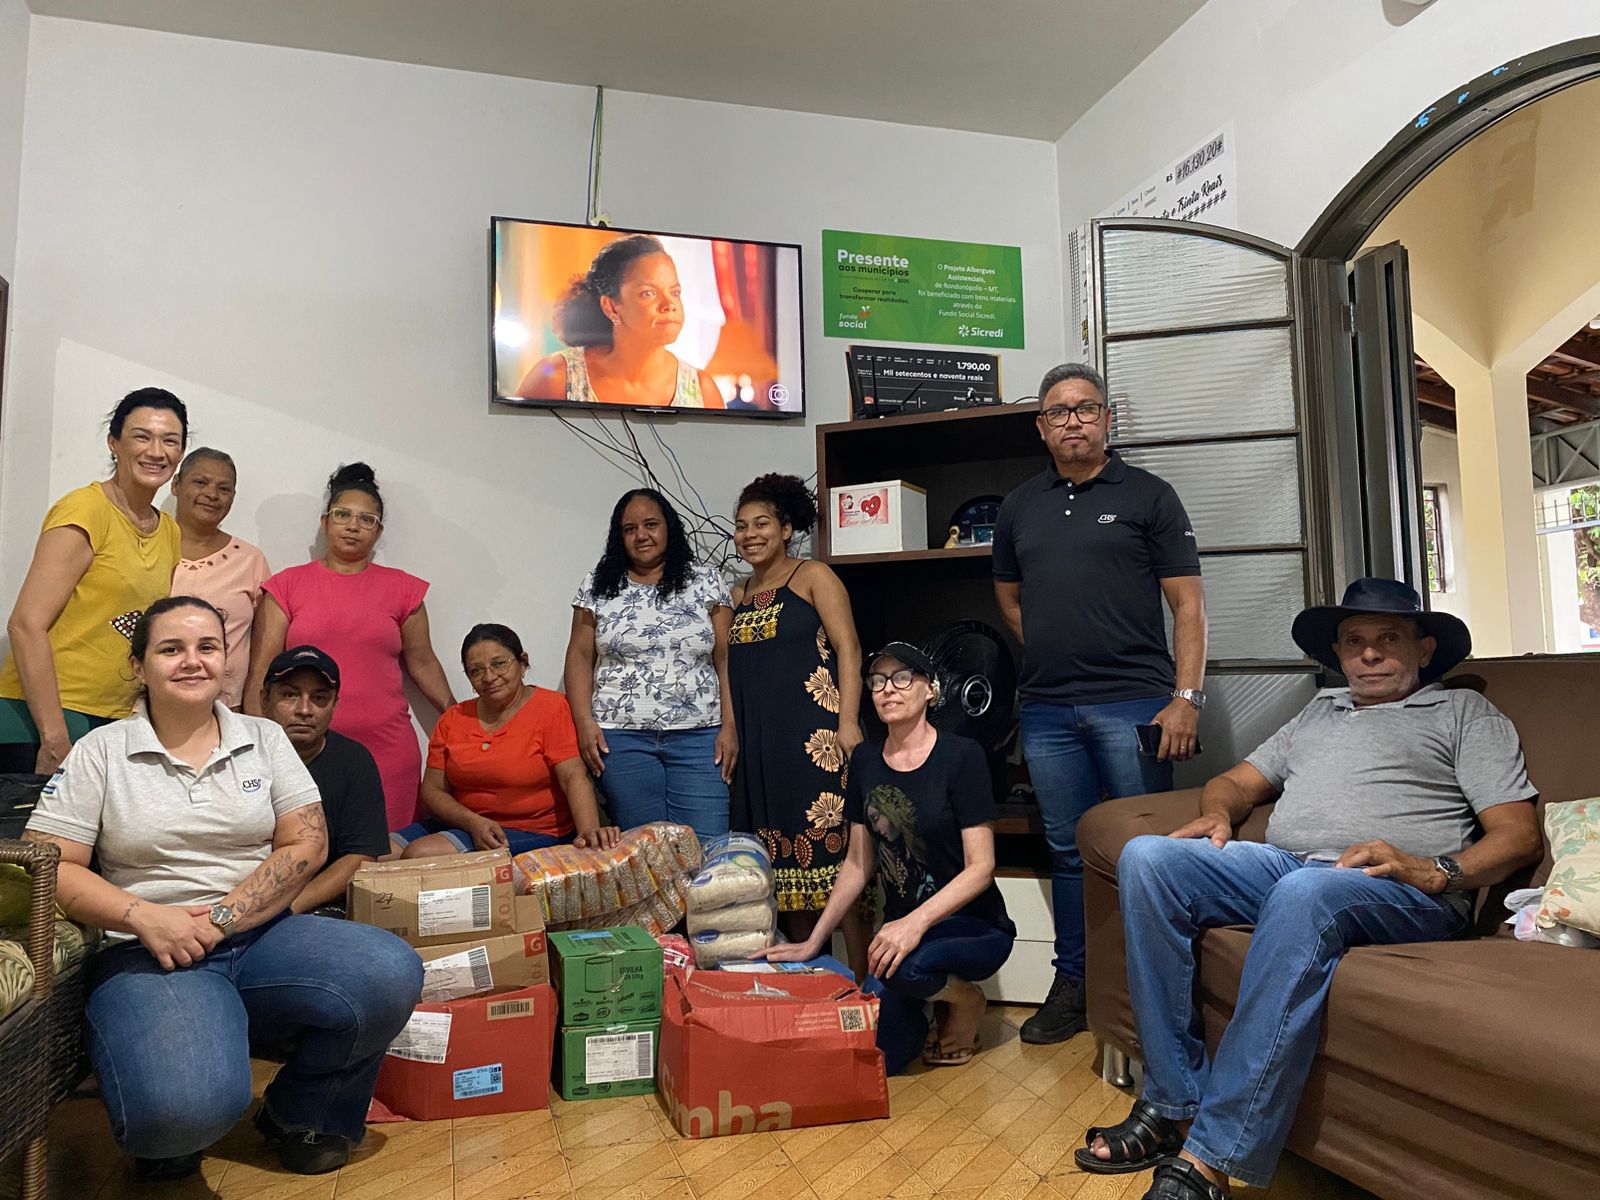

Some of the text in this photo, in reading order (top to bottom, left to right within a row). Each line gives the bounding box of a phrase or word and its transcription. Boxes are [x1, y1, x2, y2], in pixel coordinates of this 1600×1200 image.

[1177, 190, 1200, 213] Trinta
[1201, 174, 1223, 197] Reais
[837, 248, 909, 268] Presente
[838, 264, 909, 277] aos municípios
[944, 264, 966, 273] Projeto
[966, 266, 996, 275] Albergues
[947, 273, 986, 283] Assistenciais,
[853, 286, 881, 295] Cooperar
[943, 282, 983, 292] Rondonópolis
[988, 286, 999, 294] MT,
[839, 294, 877, 302] transformar
[926, 290, 960, 299] beneficiado
[938, 309, 957, 317] Fundo
[838, 320, 867, 329] social
[970, 327, 1004, 338] Sicredi
[956, 361, 991, 371] 1.790,00
[895, 370, 932, 379] setecentos
[939, 373, 966, 381] noventa
[243, 779, 259, 790] CHS
[500, 868, 510, 880] G
[529, 937, 541, 952] G
